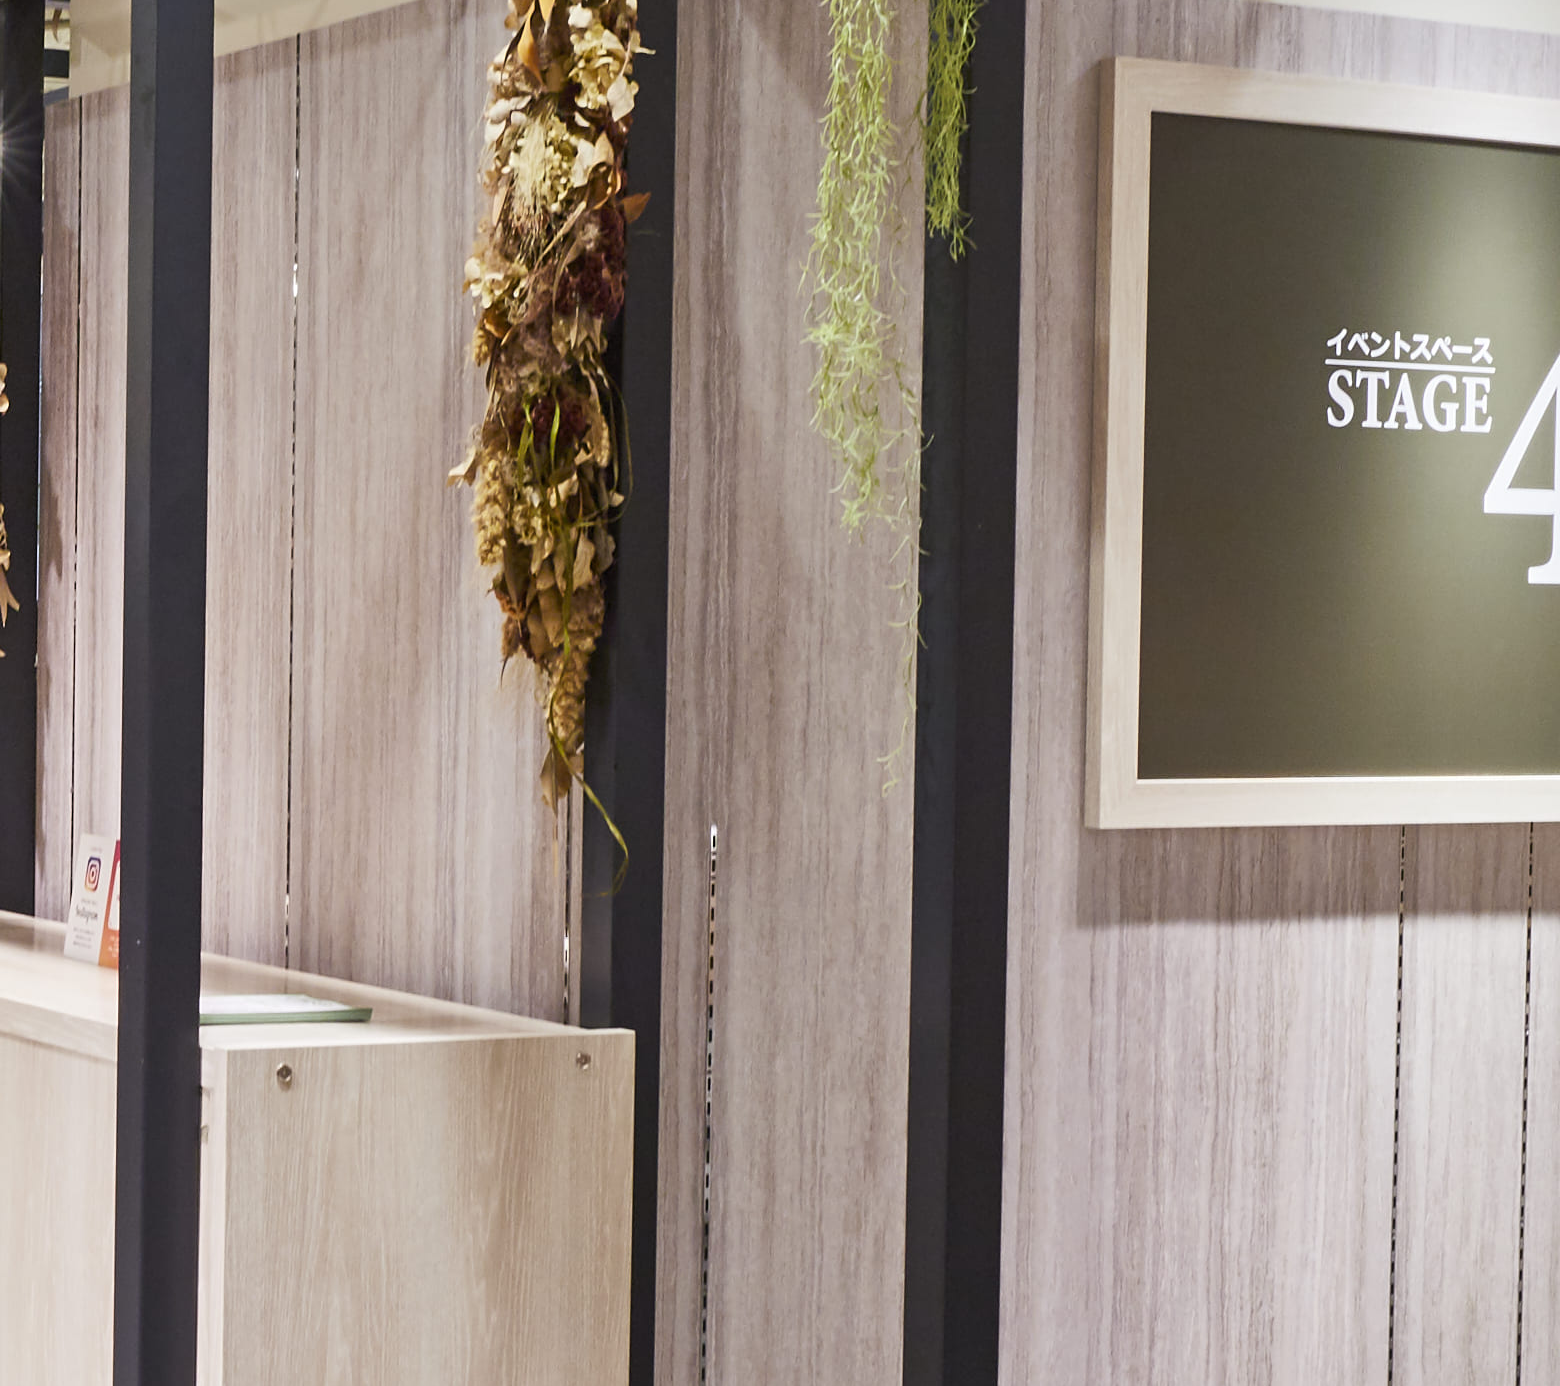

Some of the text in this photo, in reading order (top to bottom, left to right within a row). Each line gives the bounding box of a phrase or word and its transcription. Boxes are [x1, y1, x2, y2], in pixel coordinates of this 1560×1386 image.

[1326, 328, 1493, 364] イベントスペース
[1327, 369, 1492, 433] STAGE
